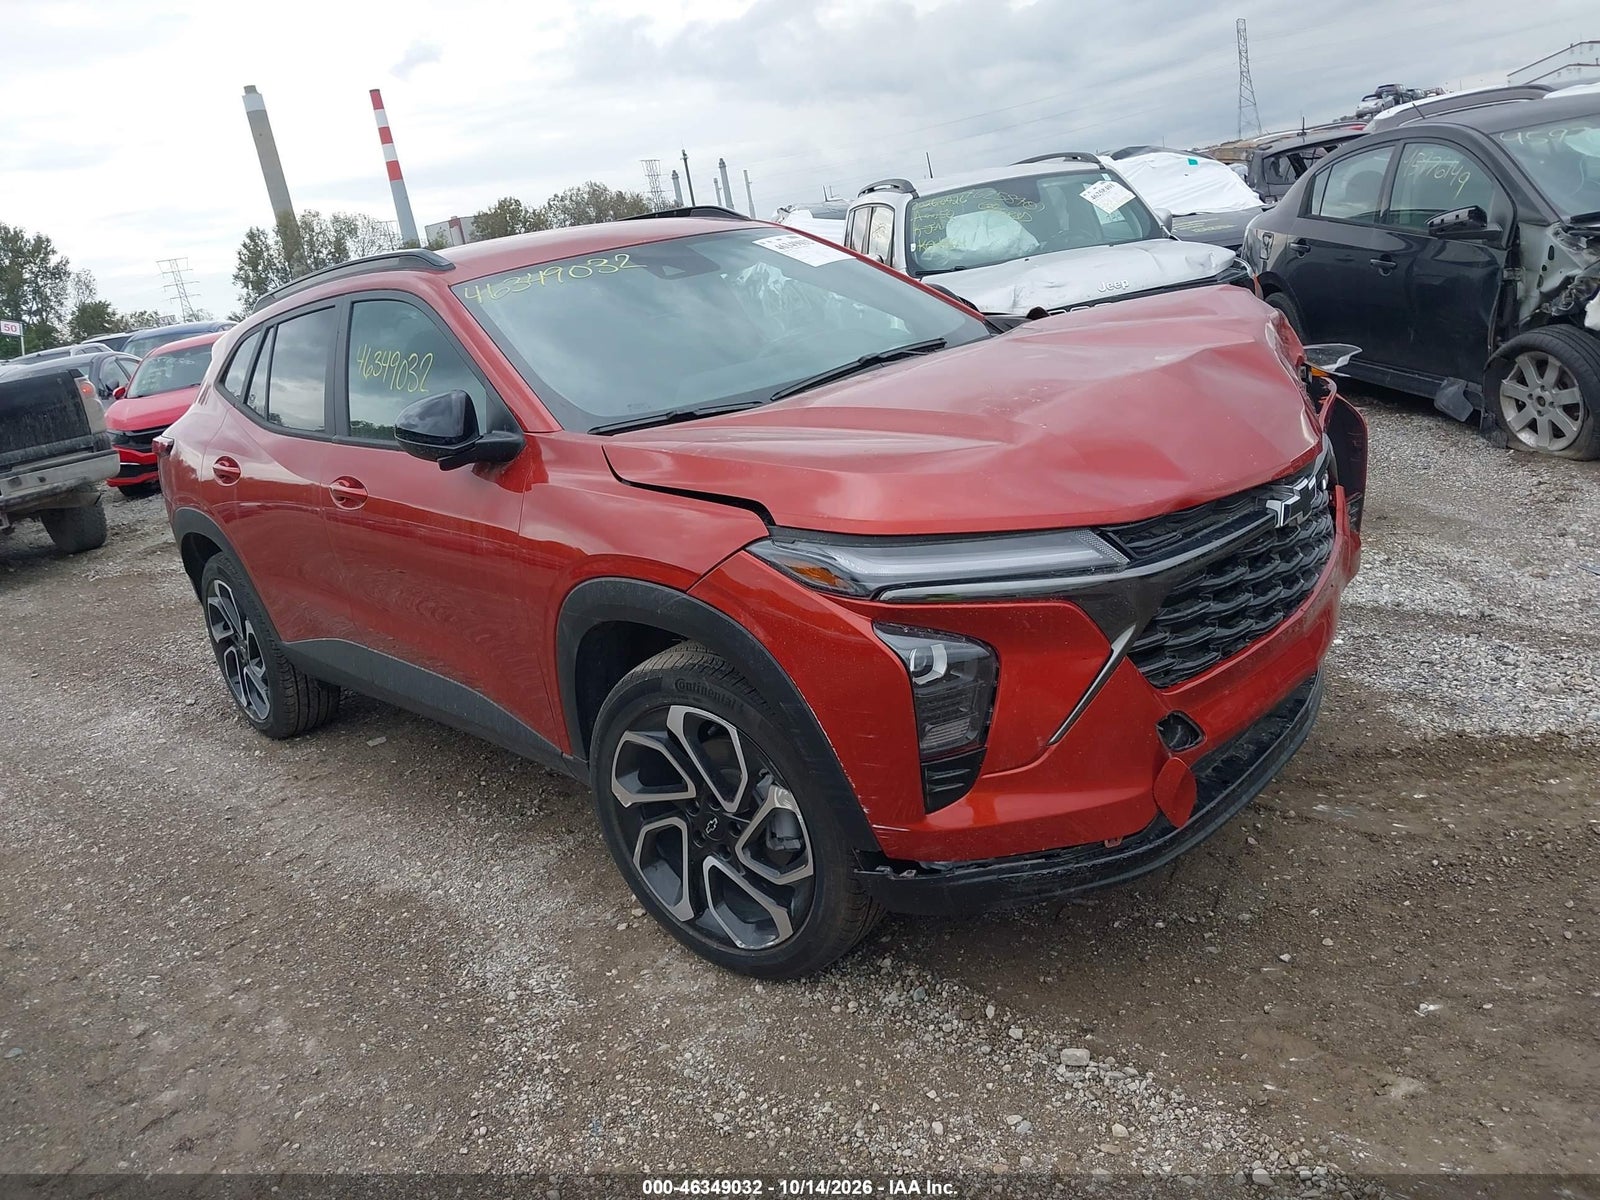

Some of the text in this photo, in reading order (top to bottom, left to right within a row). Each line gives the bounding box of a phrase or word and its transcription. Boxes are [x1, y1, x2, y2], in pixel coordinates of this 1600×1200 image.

[464, 253, 648, 304] 46349032
[1097, 279, 1129, 292] Jeep
[4, 323, 17, 332] 50
[357, 343, 434, 393] 46349032
[674, 678, 737, 710] Continental
